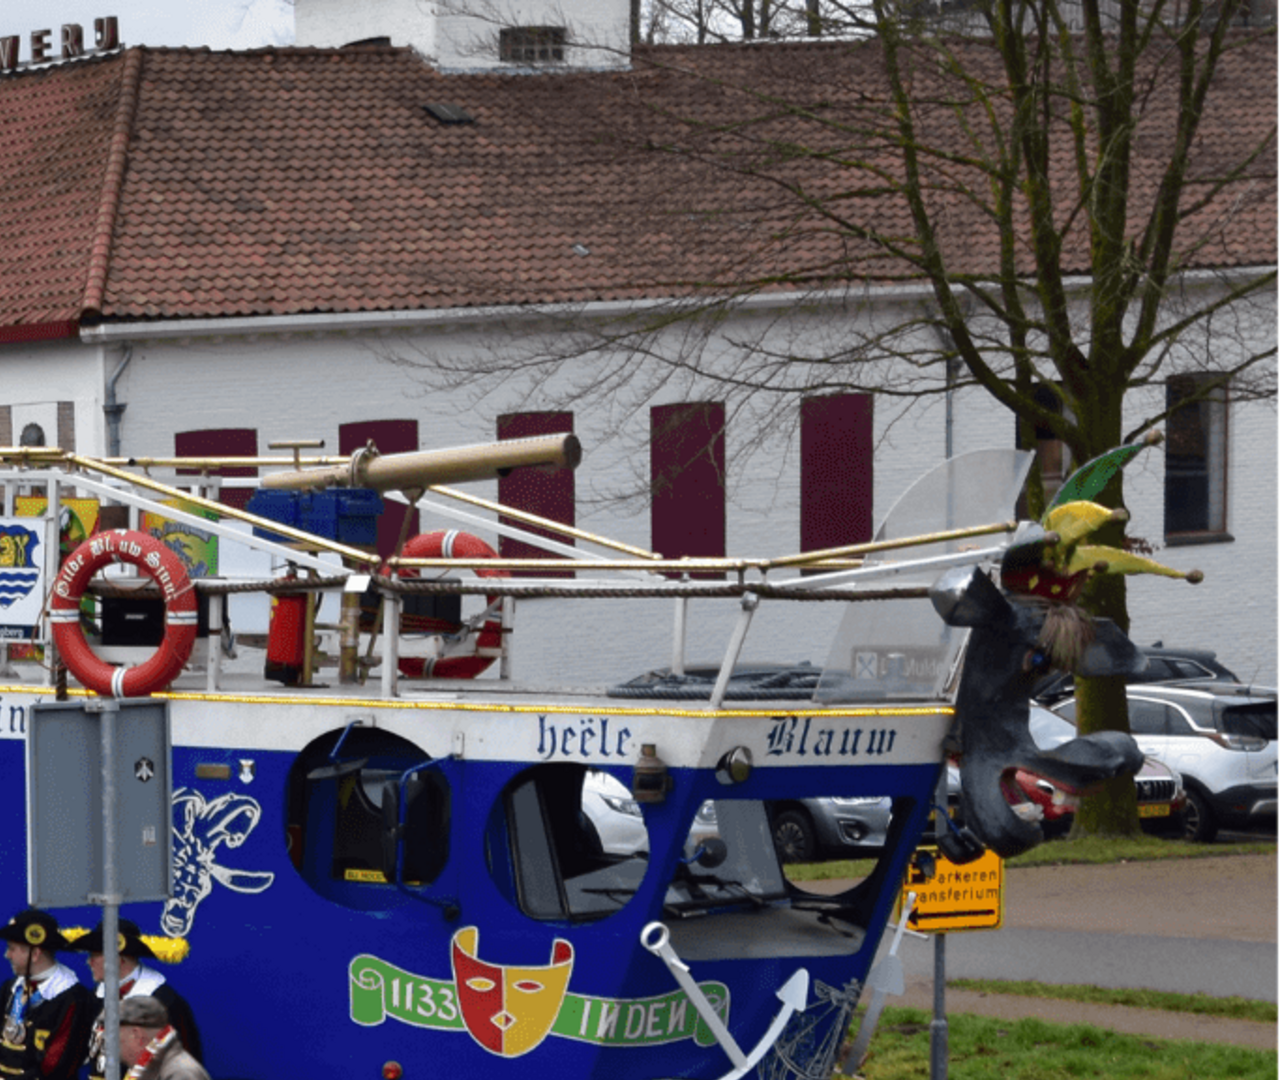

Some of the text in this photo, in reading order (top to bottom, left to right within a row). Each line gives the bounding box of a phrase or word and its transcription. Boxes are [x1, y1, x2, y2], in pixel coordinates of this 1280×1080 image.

[90, 537, 142, 559] Bluw
[537, 714, 632, 760] heële
[764, 715, 898, 756] Blauw
[936, 869, 998, 884] arkeren
[391, 977, 460, 1021] 1133
